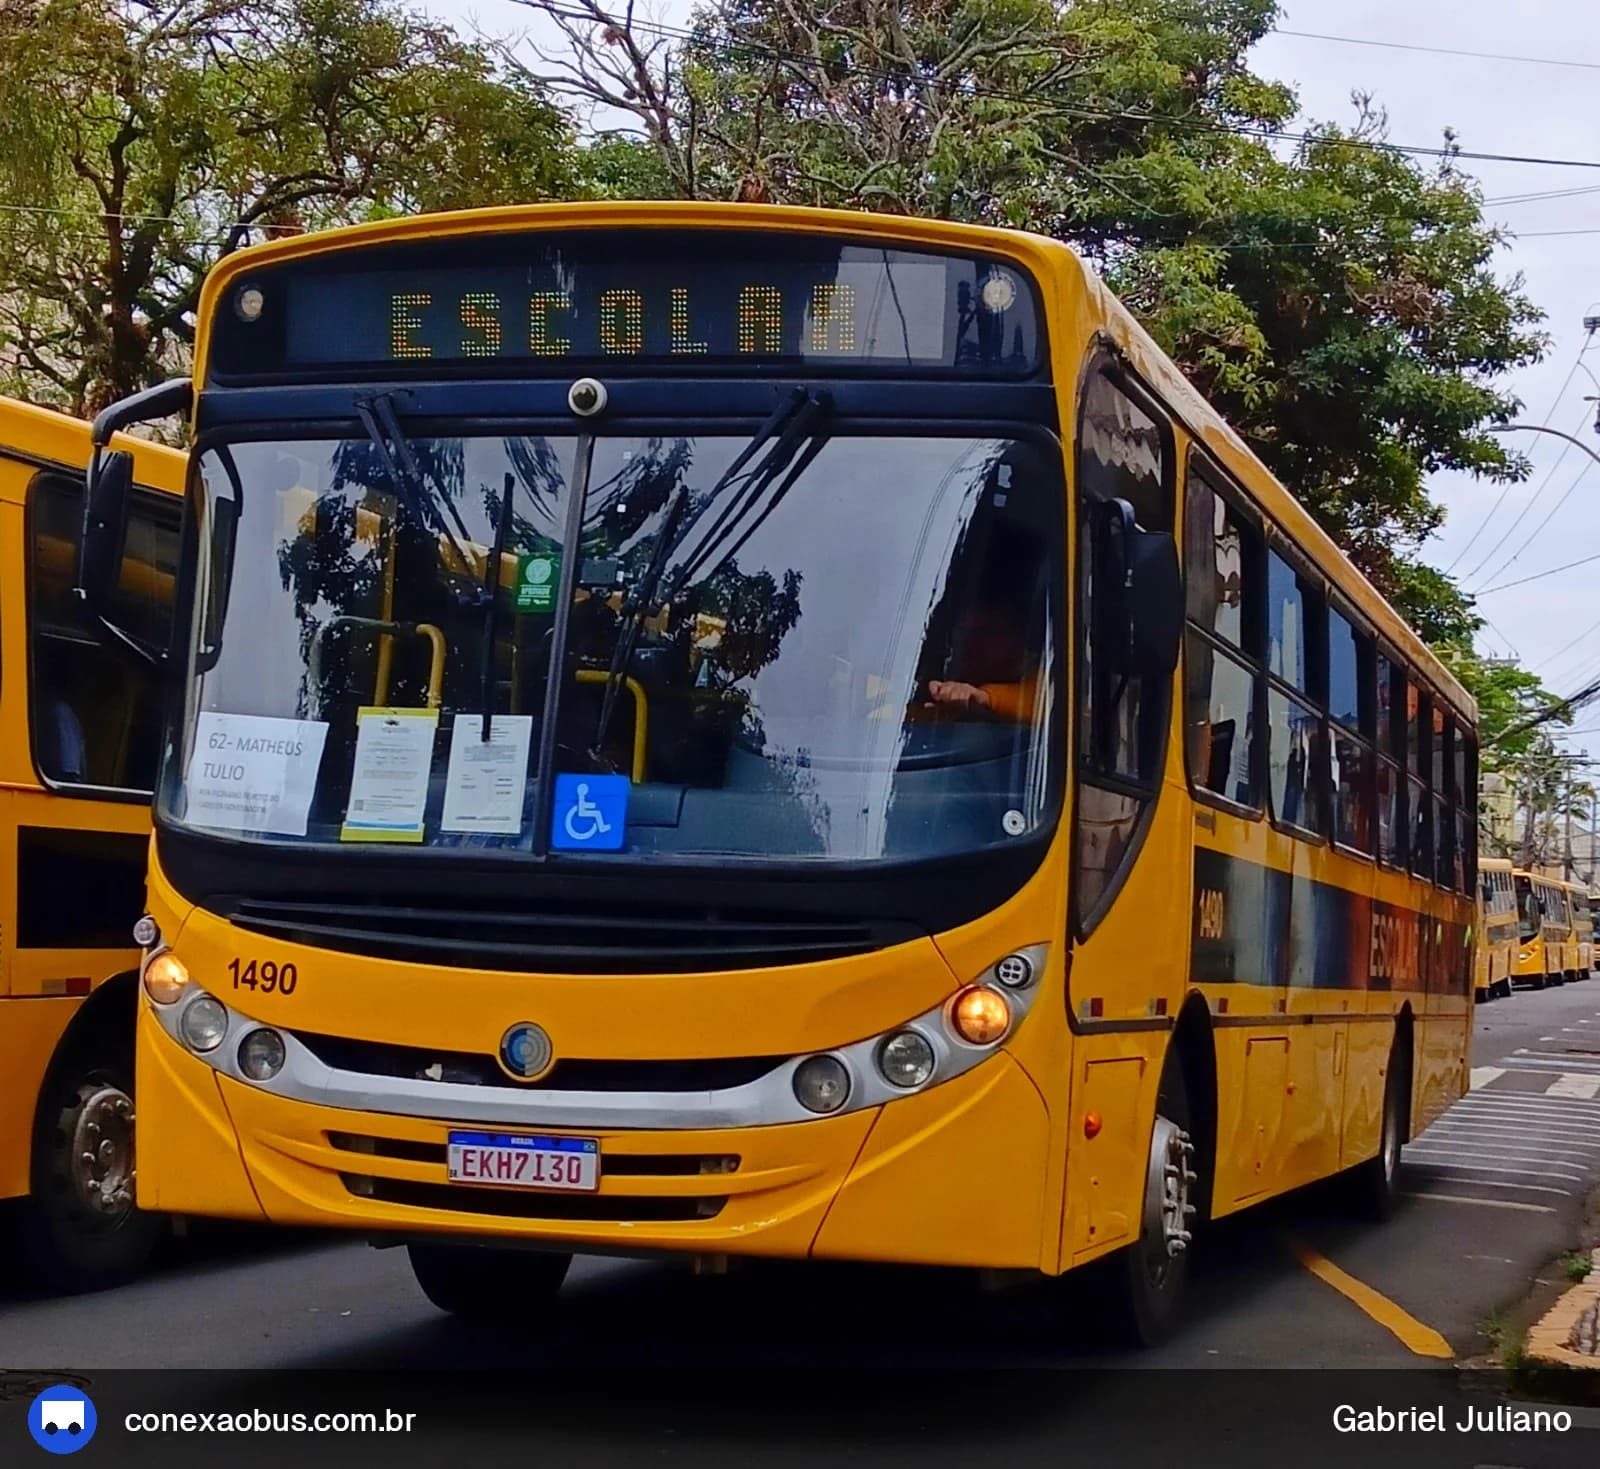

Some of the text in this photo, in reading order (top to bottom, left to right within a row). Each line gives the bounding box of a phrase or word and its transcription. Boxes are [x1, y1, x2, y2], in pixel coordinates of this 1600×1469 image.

[208, 733, 304, 756] 62- MATHEUS
[203, 763, 245, 780] TULIO
[1200, 888, 1224, 939] 1490
[228, 957, 297, 995] 1490
[462, 1149, 581, 1184] EKH7I30
